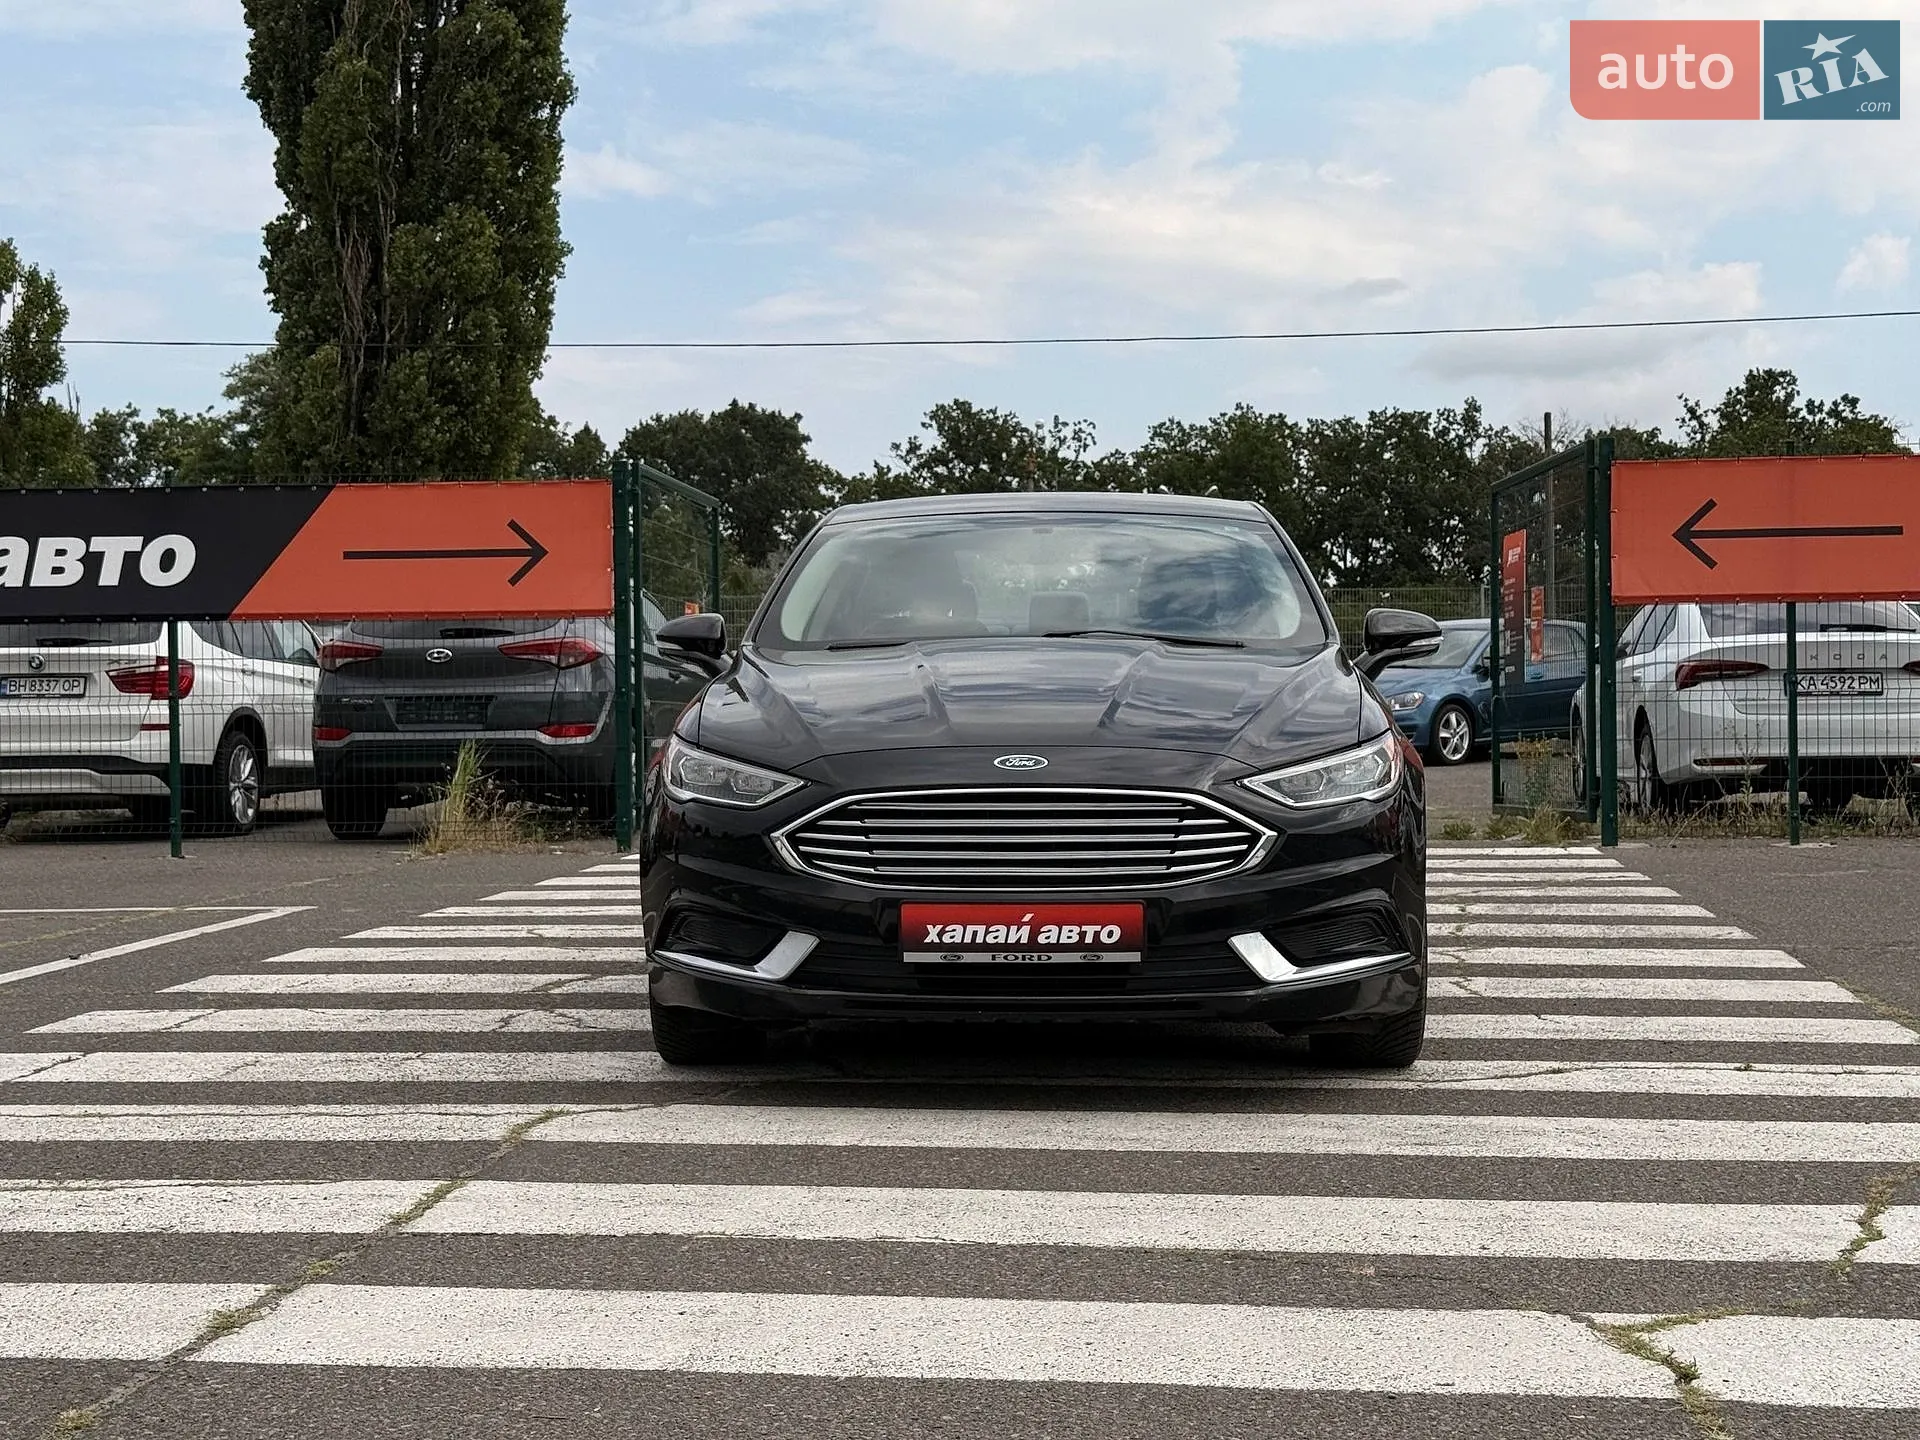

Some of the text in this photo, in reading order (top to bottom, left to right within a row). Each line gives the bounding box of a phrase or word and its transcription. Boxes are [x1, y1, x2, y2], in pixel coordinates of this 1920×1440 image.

[8, 679, 81, 693] BH 8337 OP
[1820, 675, 1856, 690] 4592
[1858, 675, 1880, 690] PM
[1005, 756, 1037, 767] Ford
[1037, 924, 1121, 945] авто
[990, 953, 1053, 962] FORD
